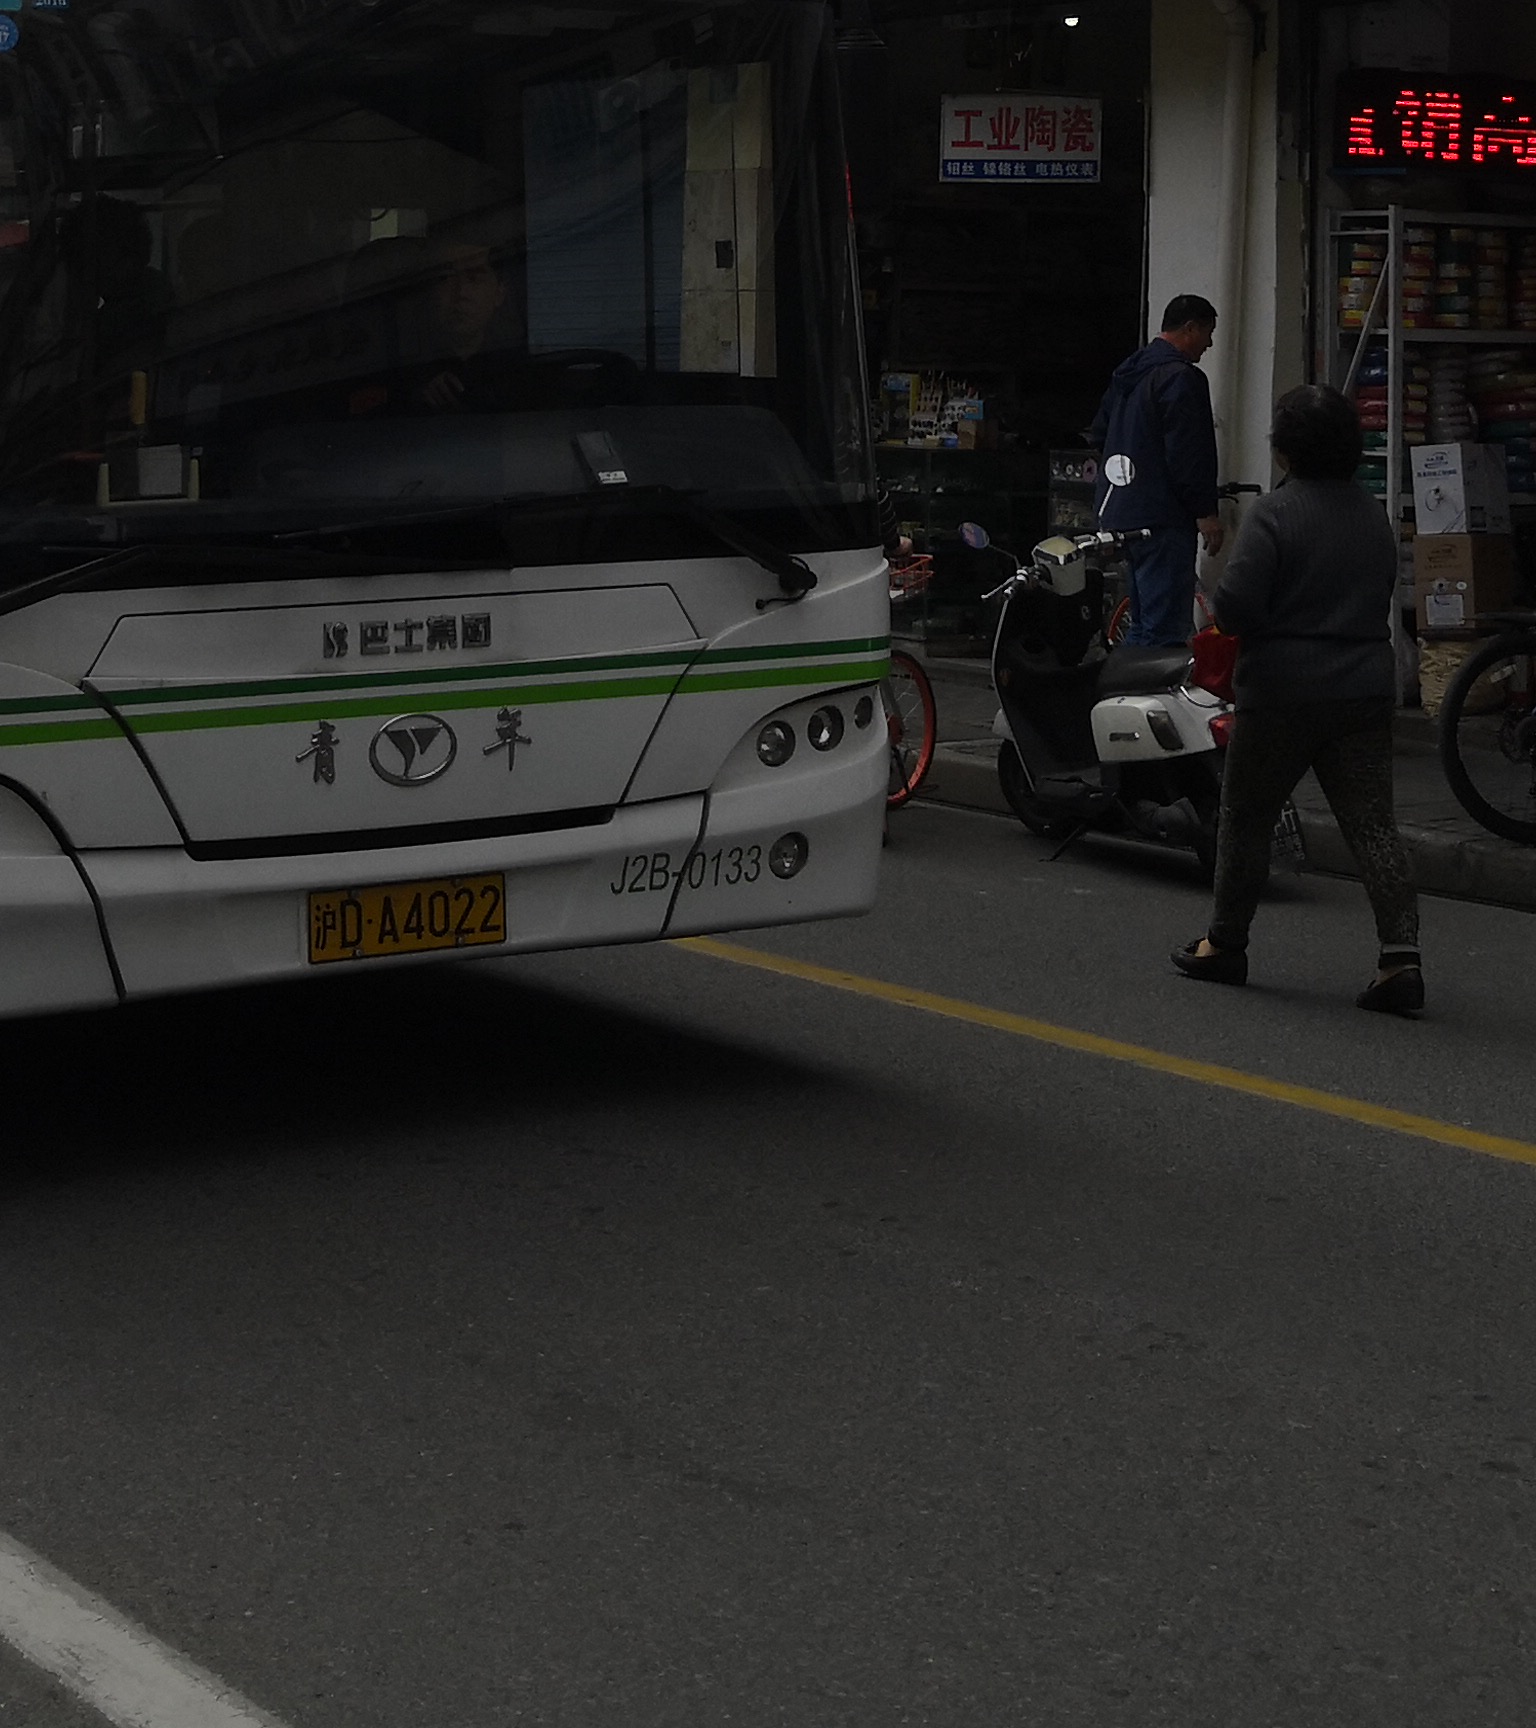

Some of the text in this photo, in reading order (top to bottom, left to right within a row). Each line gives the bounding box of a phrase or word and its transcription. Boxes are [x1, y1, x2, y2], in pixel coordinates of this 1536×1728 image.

[951, 104, 1095, 152] 工业陶瓷
[360, 612, 492, 655] 巴士集团
[610, 844, 763, 896] J2B-0133
